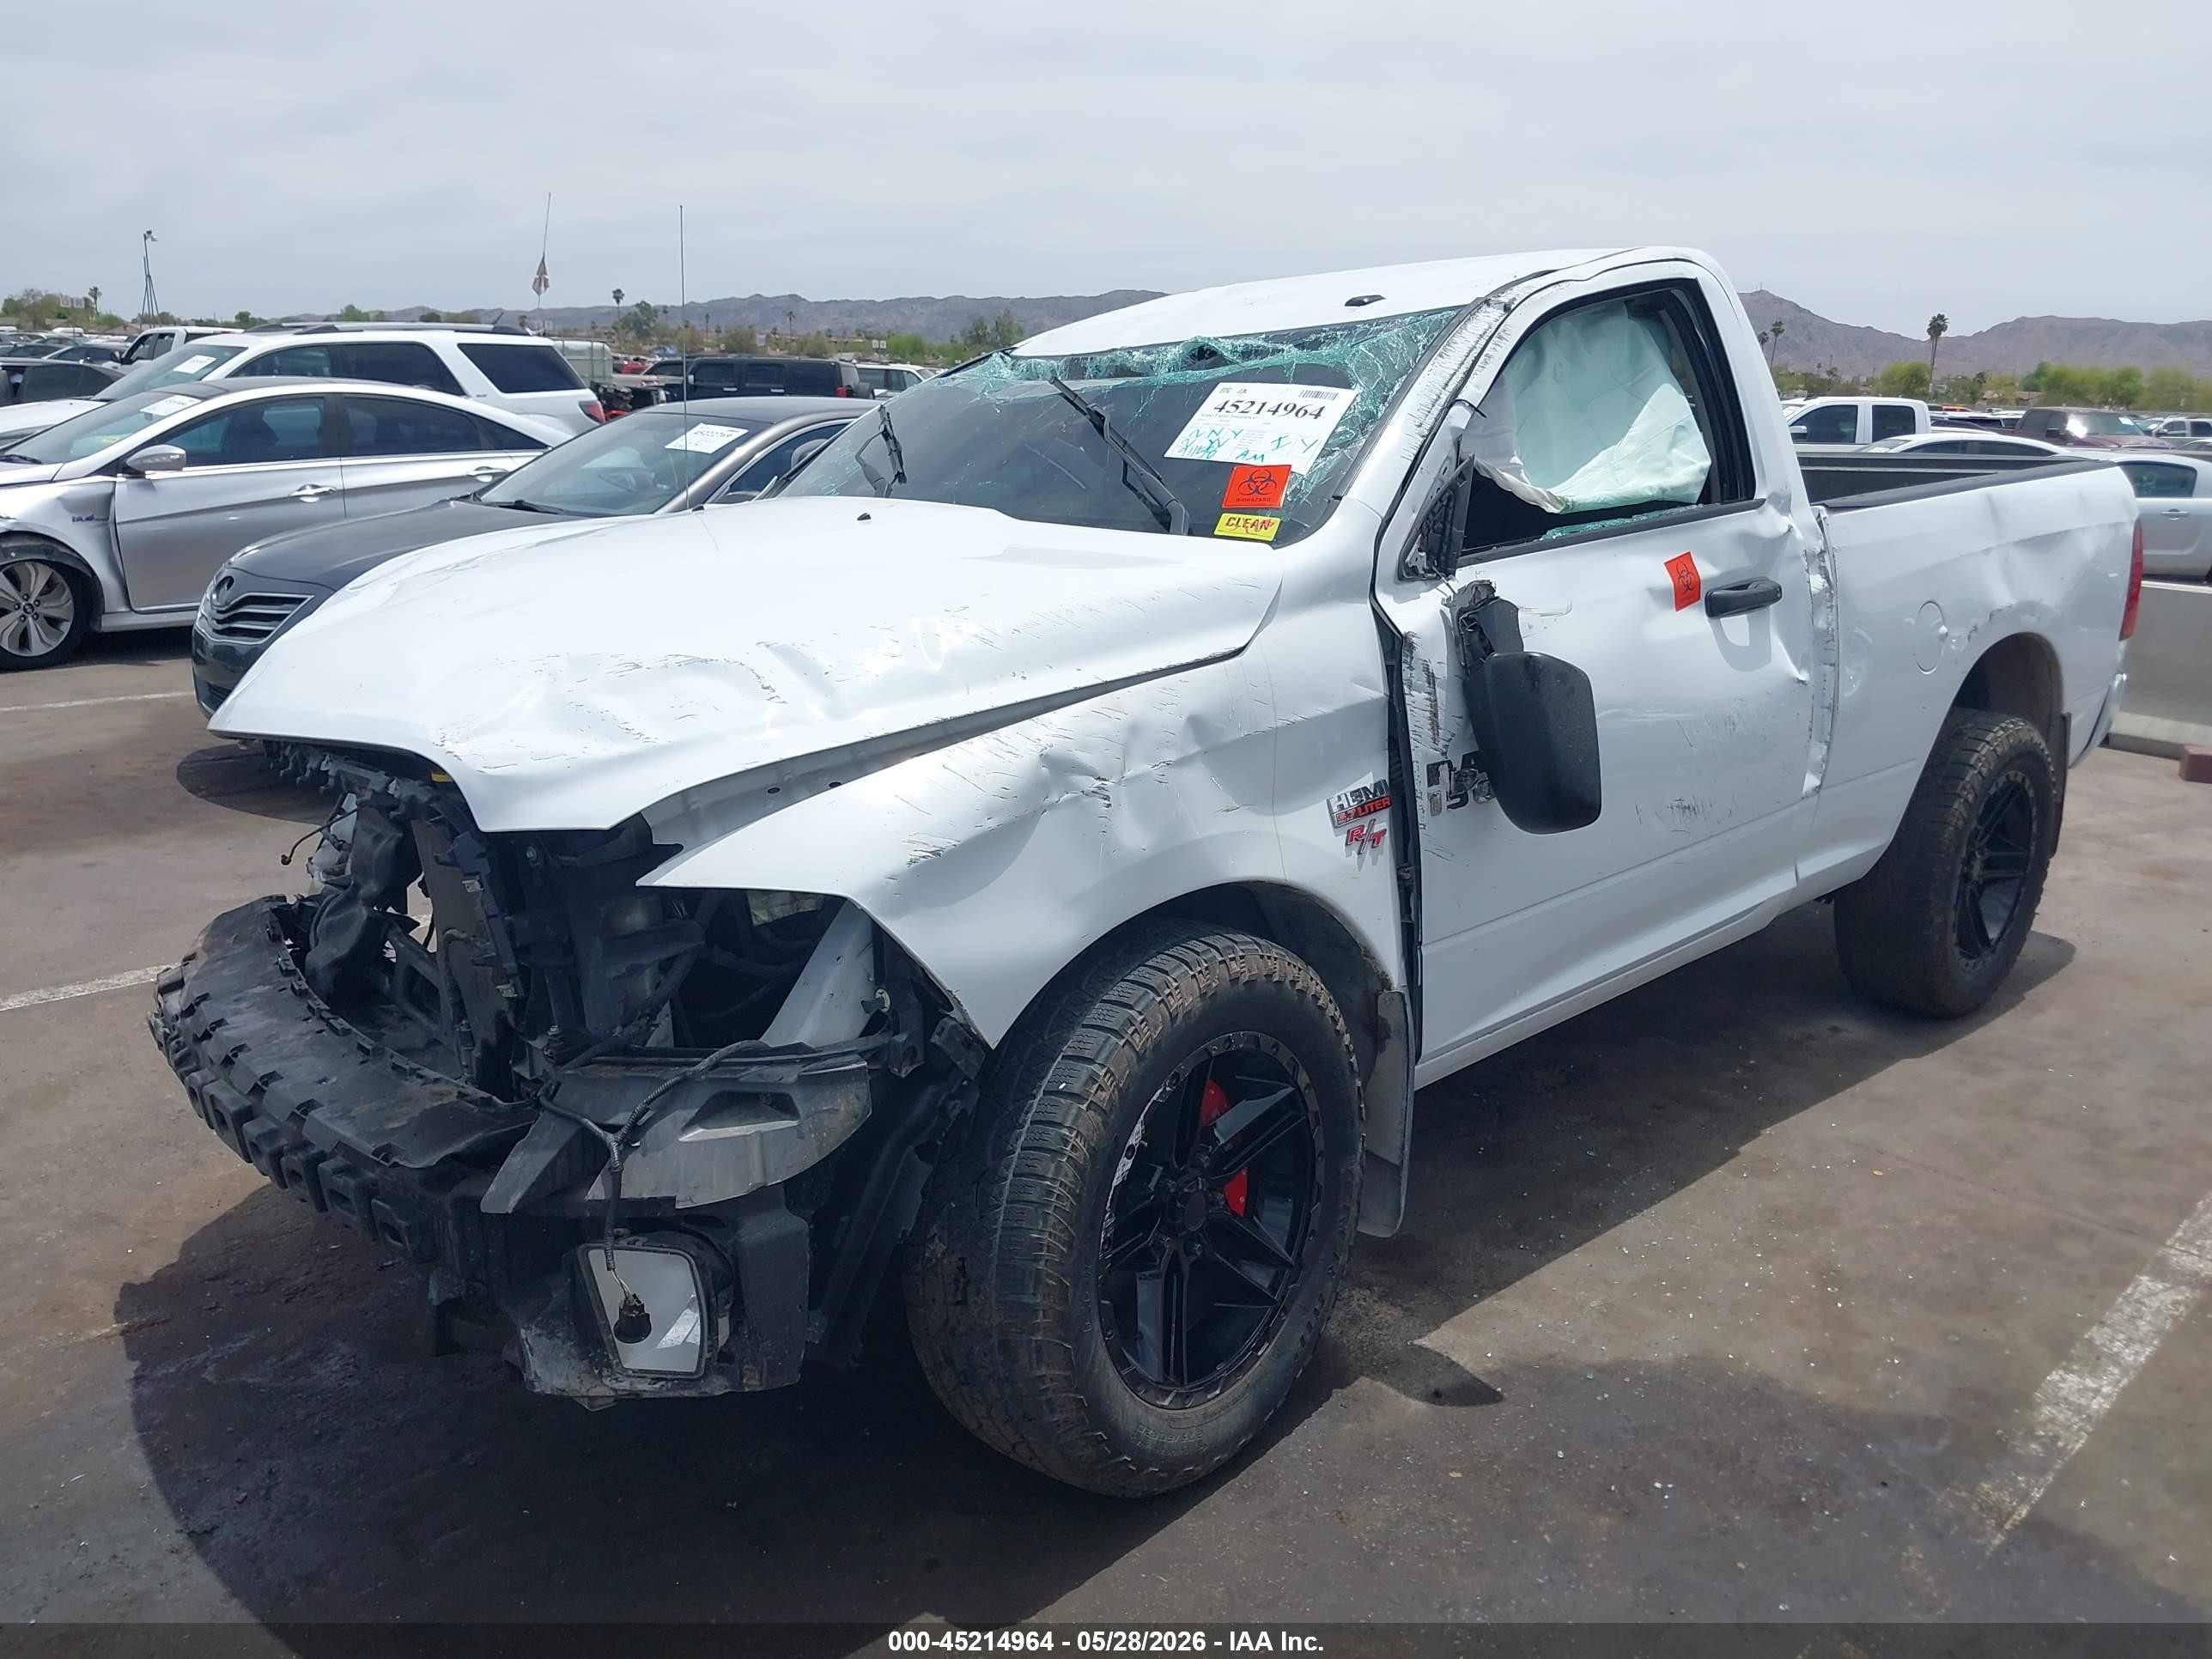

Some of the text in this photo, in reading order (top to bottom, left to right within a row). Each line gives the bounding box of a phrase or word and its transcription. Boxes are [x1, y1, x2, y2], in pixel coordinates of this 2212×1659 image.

[1214, 399, 1326, 420] 45214964
[1225, 517, 1270, 531] CLEAN
[1328, 779, 1389, 813] HEMI
[1357, 797, 1392, 817] LITER
[1345, 818, 1388, 854] R/T
